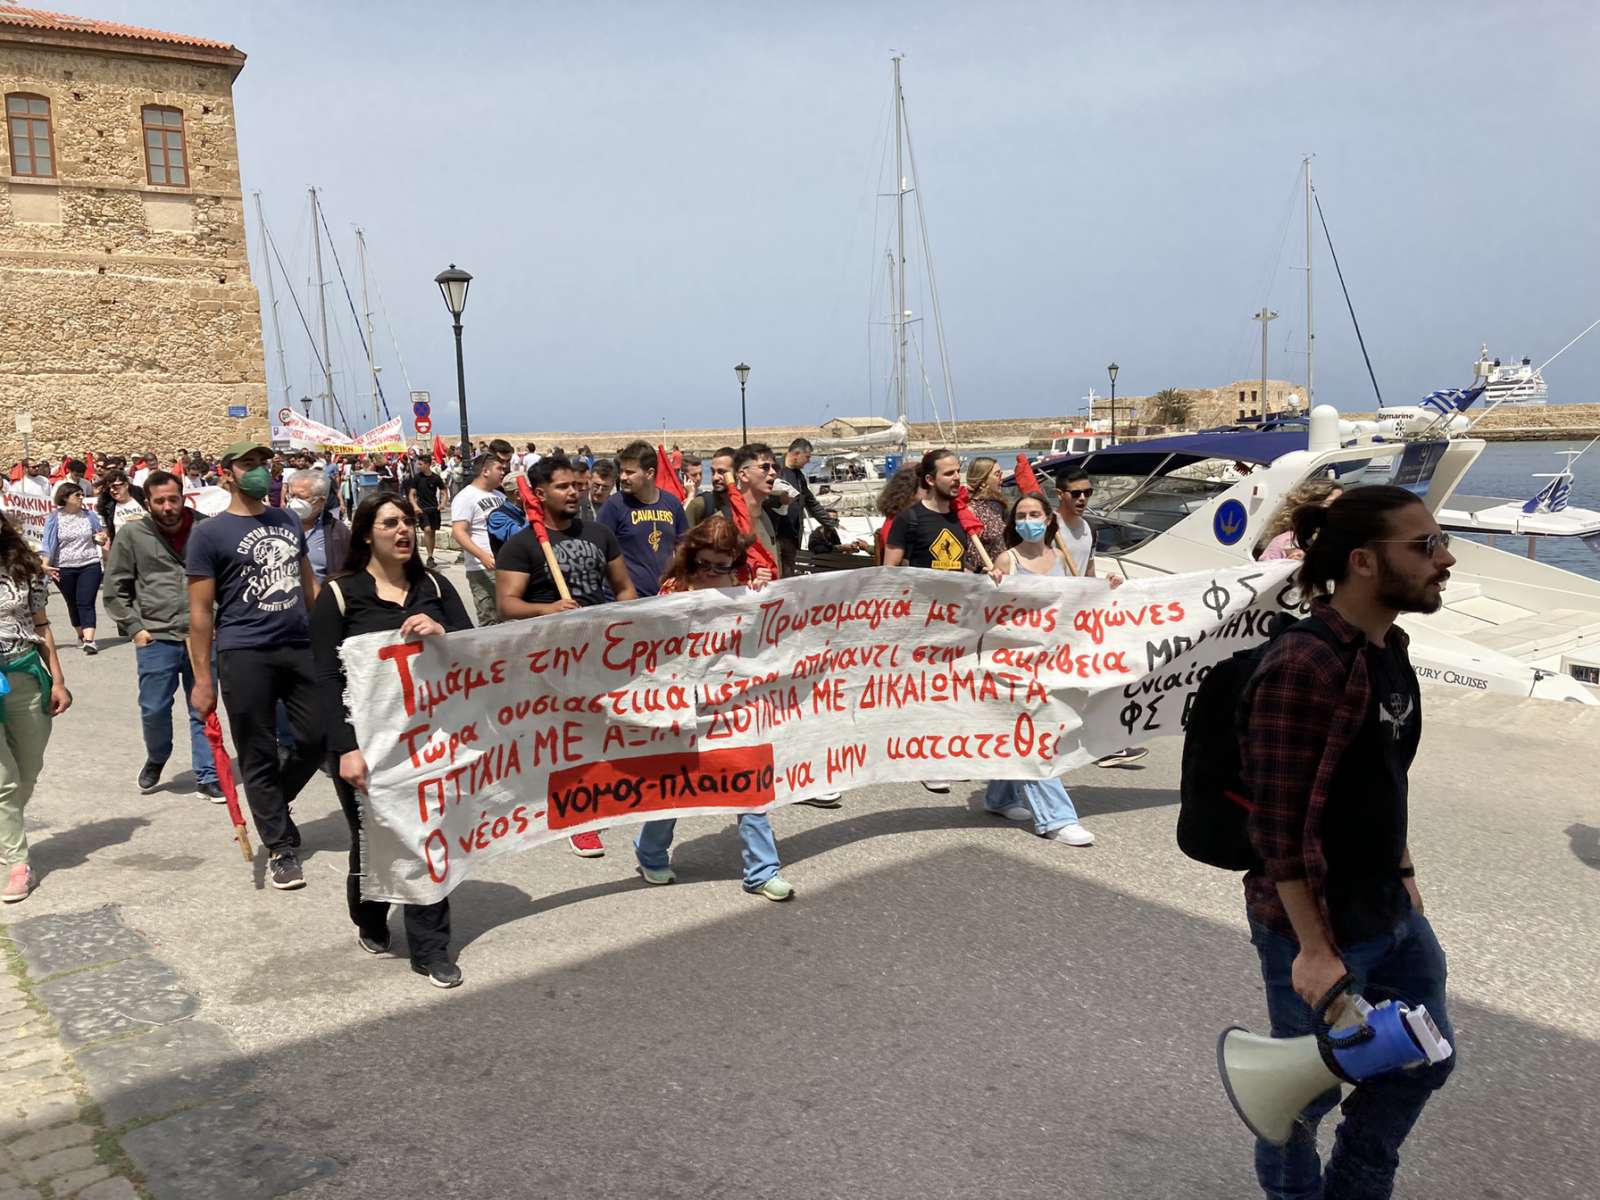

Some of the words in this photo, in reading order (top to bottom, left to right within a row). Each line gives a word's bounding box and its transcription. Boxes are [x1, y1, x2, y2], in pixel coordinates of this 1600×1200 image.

[237, 526, 268, 555] CUSTOM
[268, 525, 298, 545] BIKERS
[631, 509, 674, 525] CAVALIERS
[378, 640, 506, 718] Τιμάμε
[528, 642, 590, 677] την
[602, 621, 742, 678] Εργατική
[758, 588, 913, 648] Πρωτομαγιά
[924, 599, 962, 629] με
[983, 597, 1058, 635] νέους
[1073, 600, 1186, 646] αγώνες
[399, 723, 478, 769] Τώρα
[497, 672, 691, 727] ουσιαστικά
[791, 640, 899, 681] απέναντι
[990, 643, 1132, 680] ακρίβεια
[1443, 670, 1489, 690] CRUISES
[417, 738, 521, 824] ΠΤΥΧΙΑ
[533, 720, 584, 768] ΜΕ
[705, 684, 803, 741] ΔΟΥΛΕΙΑ
[811, 677, 848, 716] ΜΕ
[858, 670, 1049, 711] ΔΙΚΑΙΩΜΑΤΑ
[423, 828, 450, 884] Ο
[826, 741, 869, 785] μην
[886, 711, 1068, 761] κατατεθεί
